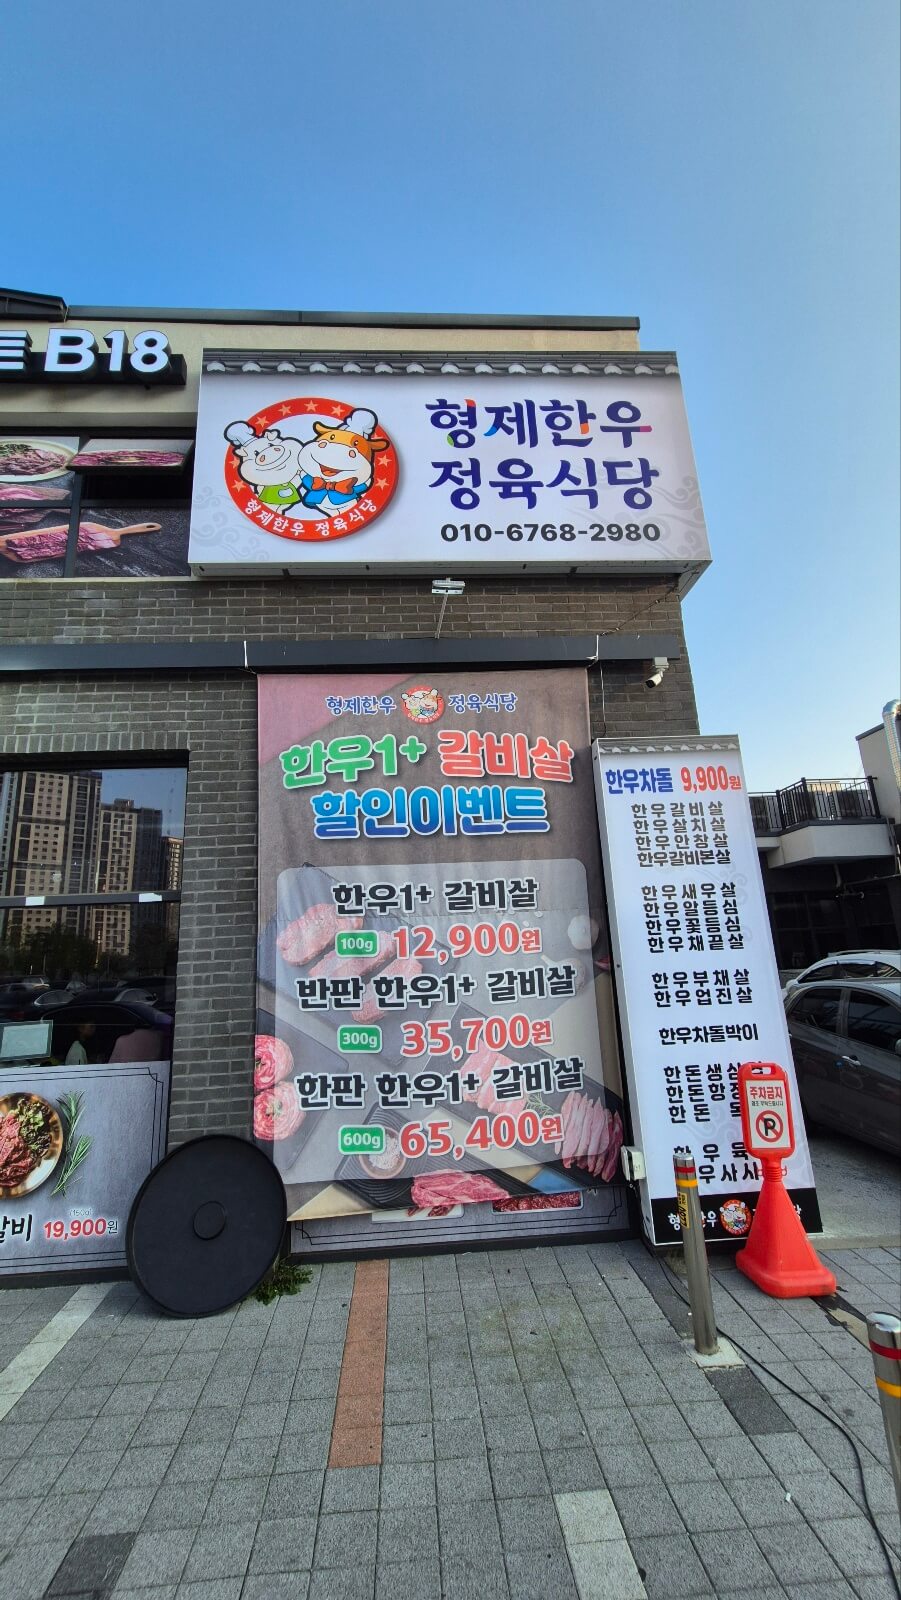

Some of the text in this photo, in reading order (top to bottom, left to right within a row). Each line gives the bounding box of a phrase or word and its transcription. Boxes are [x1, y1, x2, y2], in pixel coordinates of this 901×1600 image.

[44, 328, 170, 373] B18
[425, 398, 652, 449] 형제한우
[428, 457, 660, 510] 정육식당
[244, 499, 377, 536] 형제한우 정육식당
[440, 523, 661, 542] 010-6768-2980
[325, 692, 518, 715] 형제한우 정육식당
[279, 730, 574, 789] 한우1+ 갈비살
[605, 765, 742, 794] 한우차돌 9,900원
[310, 785, 550, 839] 할인이벤트
[637, 849, 731, 867] 한우갈비본살
[332, 878, 538, 916] 한우1+ 갈비살
[340, 922, 542, 965] 100g 12,900원
[296, 965, 577, 1011] 반판 한우1+ 갈비살
[341, 1014, 553, 1060] 300g 35,700원
[658, 1023, 759, 1045] 한우차돌박이
[295, 1057, 585, 1110] 한판 한우1+ 갈비살
[750, 1086, 783, 1100] 주차금지
[343, 1111, 564, 1160] 600g 65,400원
[44, 1218, 118, 1241] 19,900원
